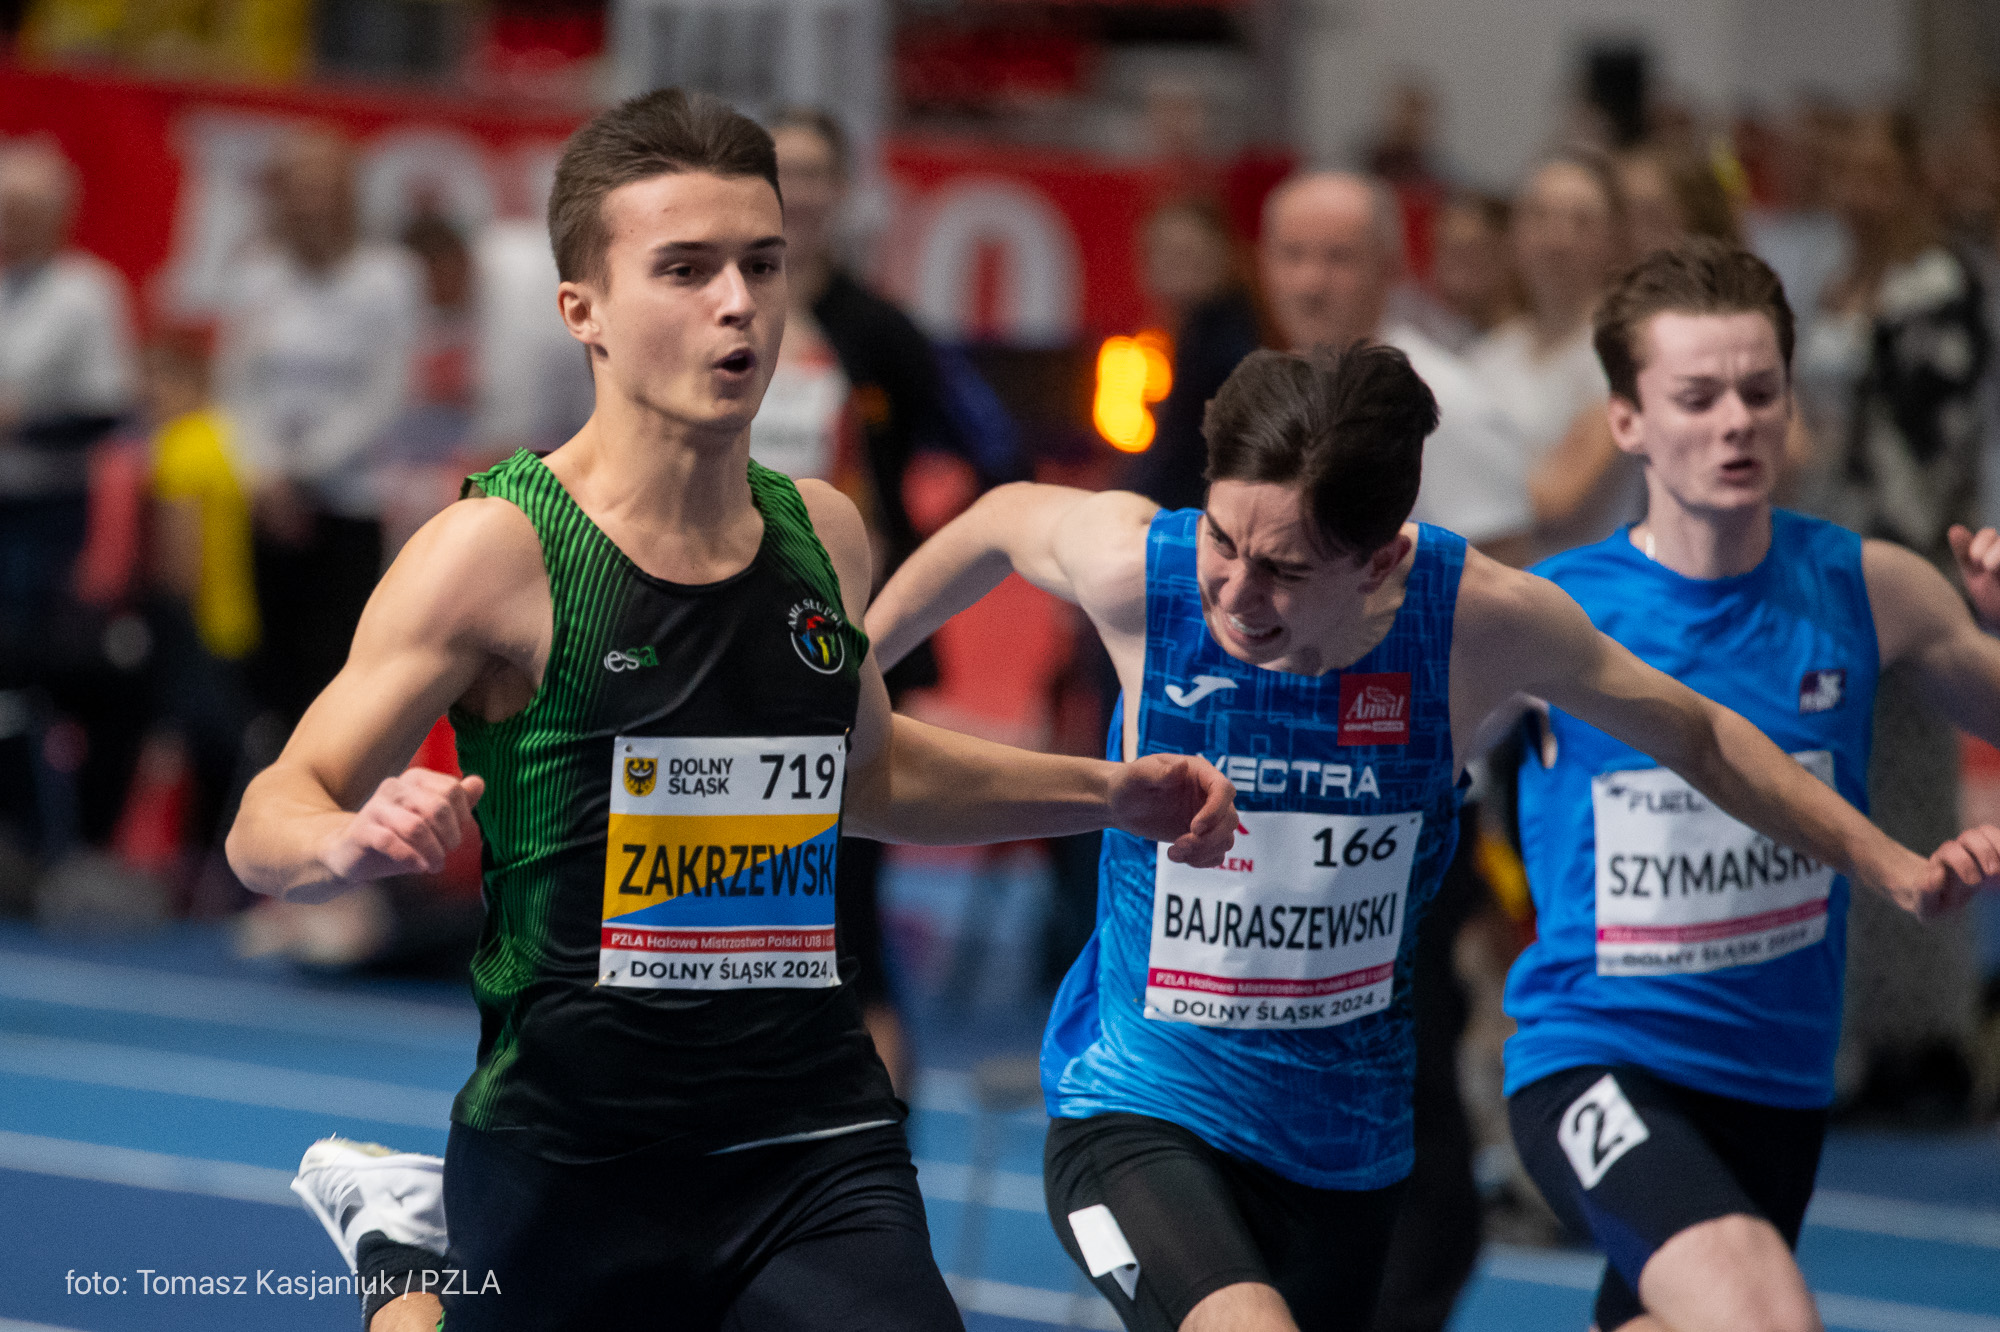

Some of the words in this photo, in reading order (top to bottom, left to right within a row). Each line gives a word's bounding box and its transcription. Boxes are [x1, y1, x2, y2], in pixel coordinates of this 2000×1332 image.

[669, 758, 733, 775] DOLNY
[760, 753, 836, 800] 719
[668, 773, 729, 798] ŚLĄSK
[1313, 825, 1398, 868] 166
[1610, 834, 1823, 898] SZYMAŃSK
[1164, 892, 1398, 950] BAJRASZEWSKI
[611, 933, 644, 947] PZLA
[647, 935, 698, 949] Halowe
[701, 935, 765, 949] Mistrzostwa
[768, 934, 803, 948] Polski
[804, 935, 822, 948] U18
[630, 960, 714, 980] DOLNY
[719, 957, 777, 984] ŚLĄSK
[782, 960, 827, 979] 2024
[1156, 971, 1187, 986] PZLA
[1173, 999, 1251, 1021] DOLNY
[1256, 1001, 1325, 1024] ŚLĄSK
[1330, 991, 1375, 1016] 2024
[1573, 1102, 1625, 1168] 2
